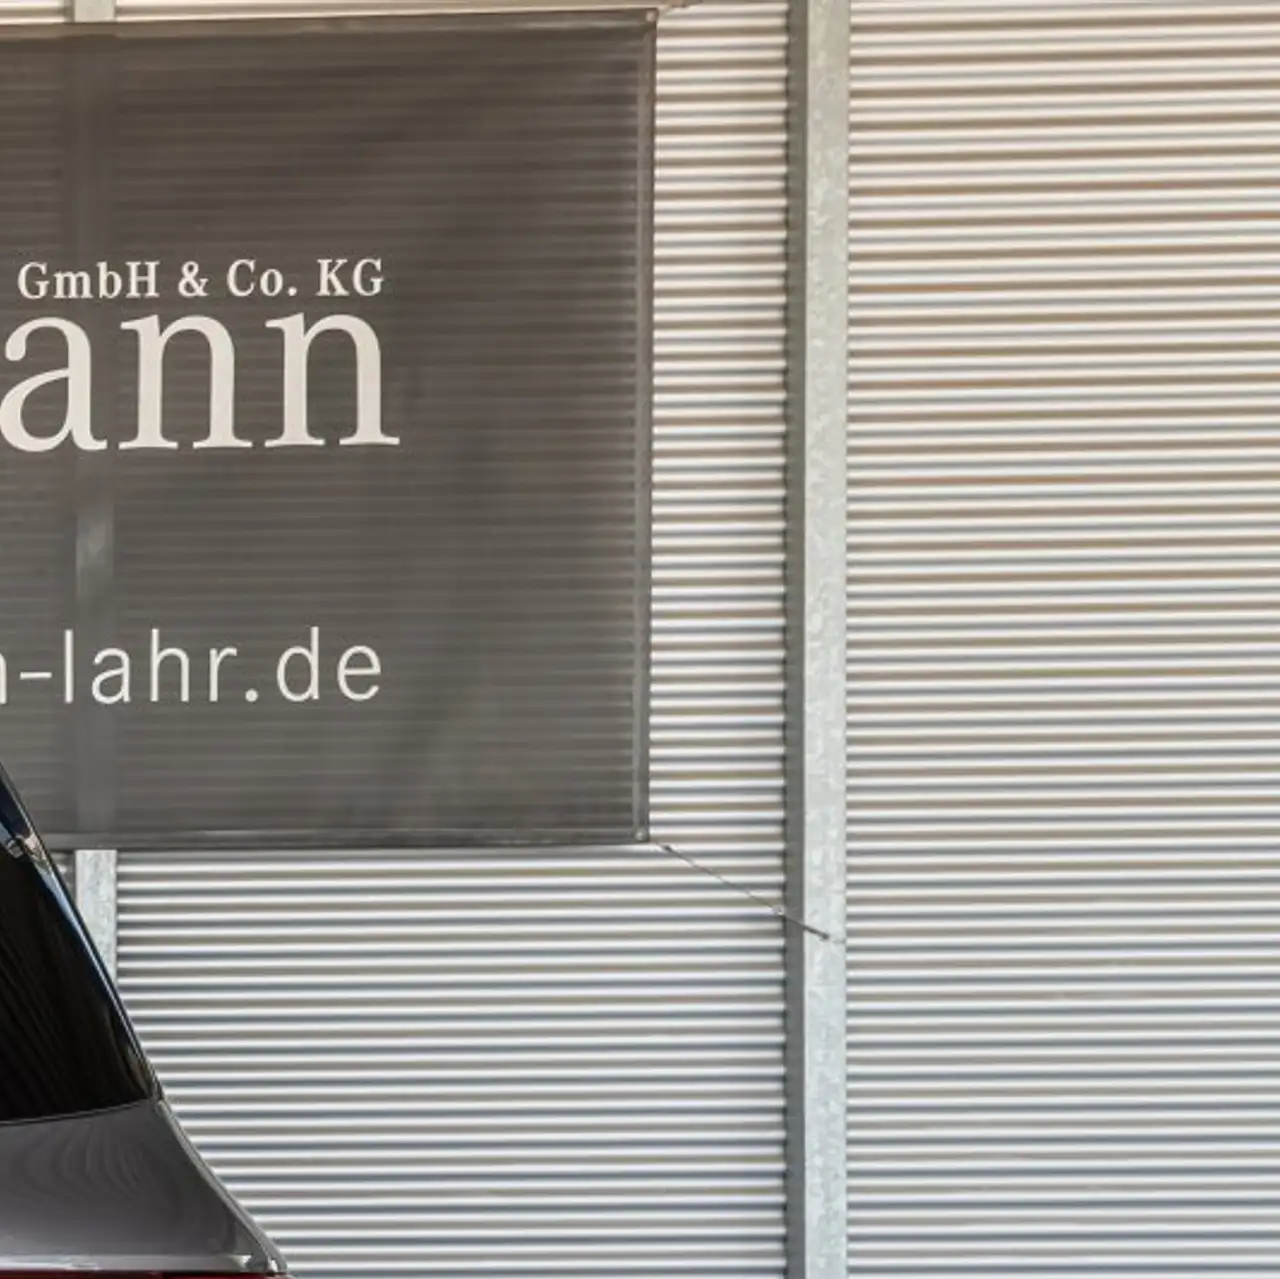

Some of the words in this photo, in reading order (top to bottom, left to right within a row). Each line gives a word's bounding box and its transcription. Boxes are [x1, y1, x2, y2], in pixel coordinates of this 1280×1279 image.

[18, 260, 159, 300] GmbH
[178, 261, 209, 298] &
[227, 259, 297, 298] Co.
[317, 258, 384, 297] KG
